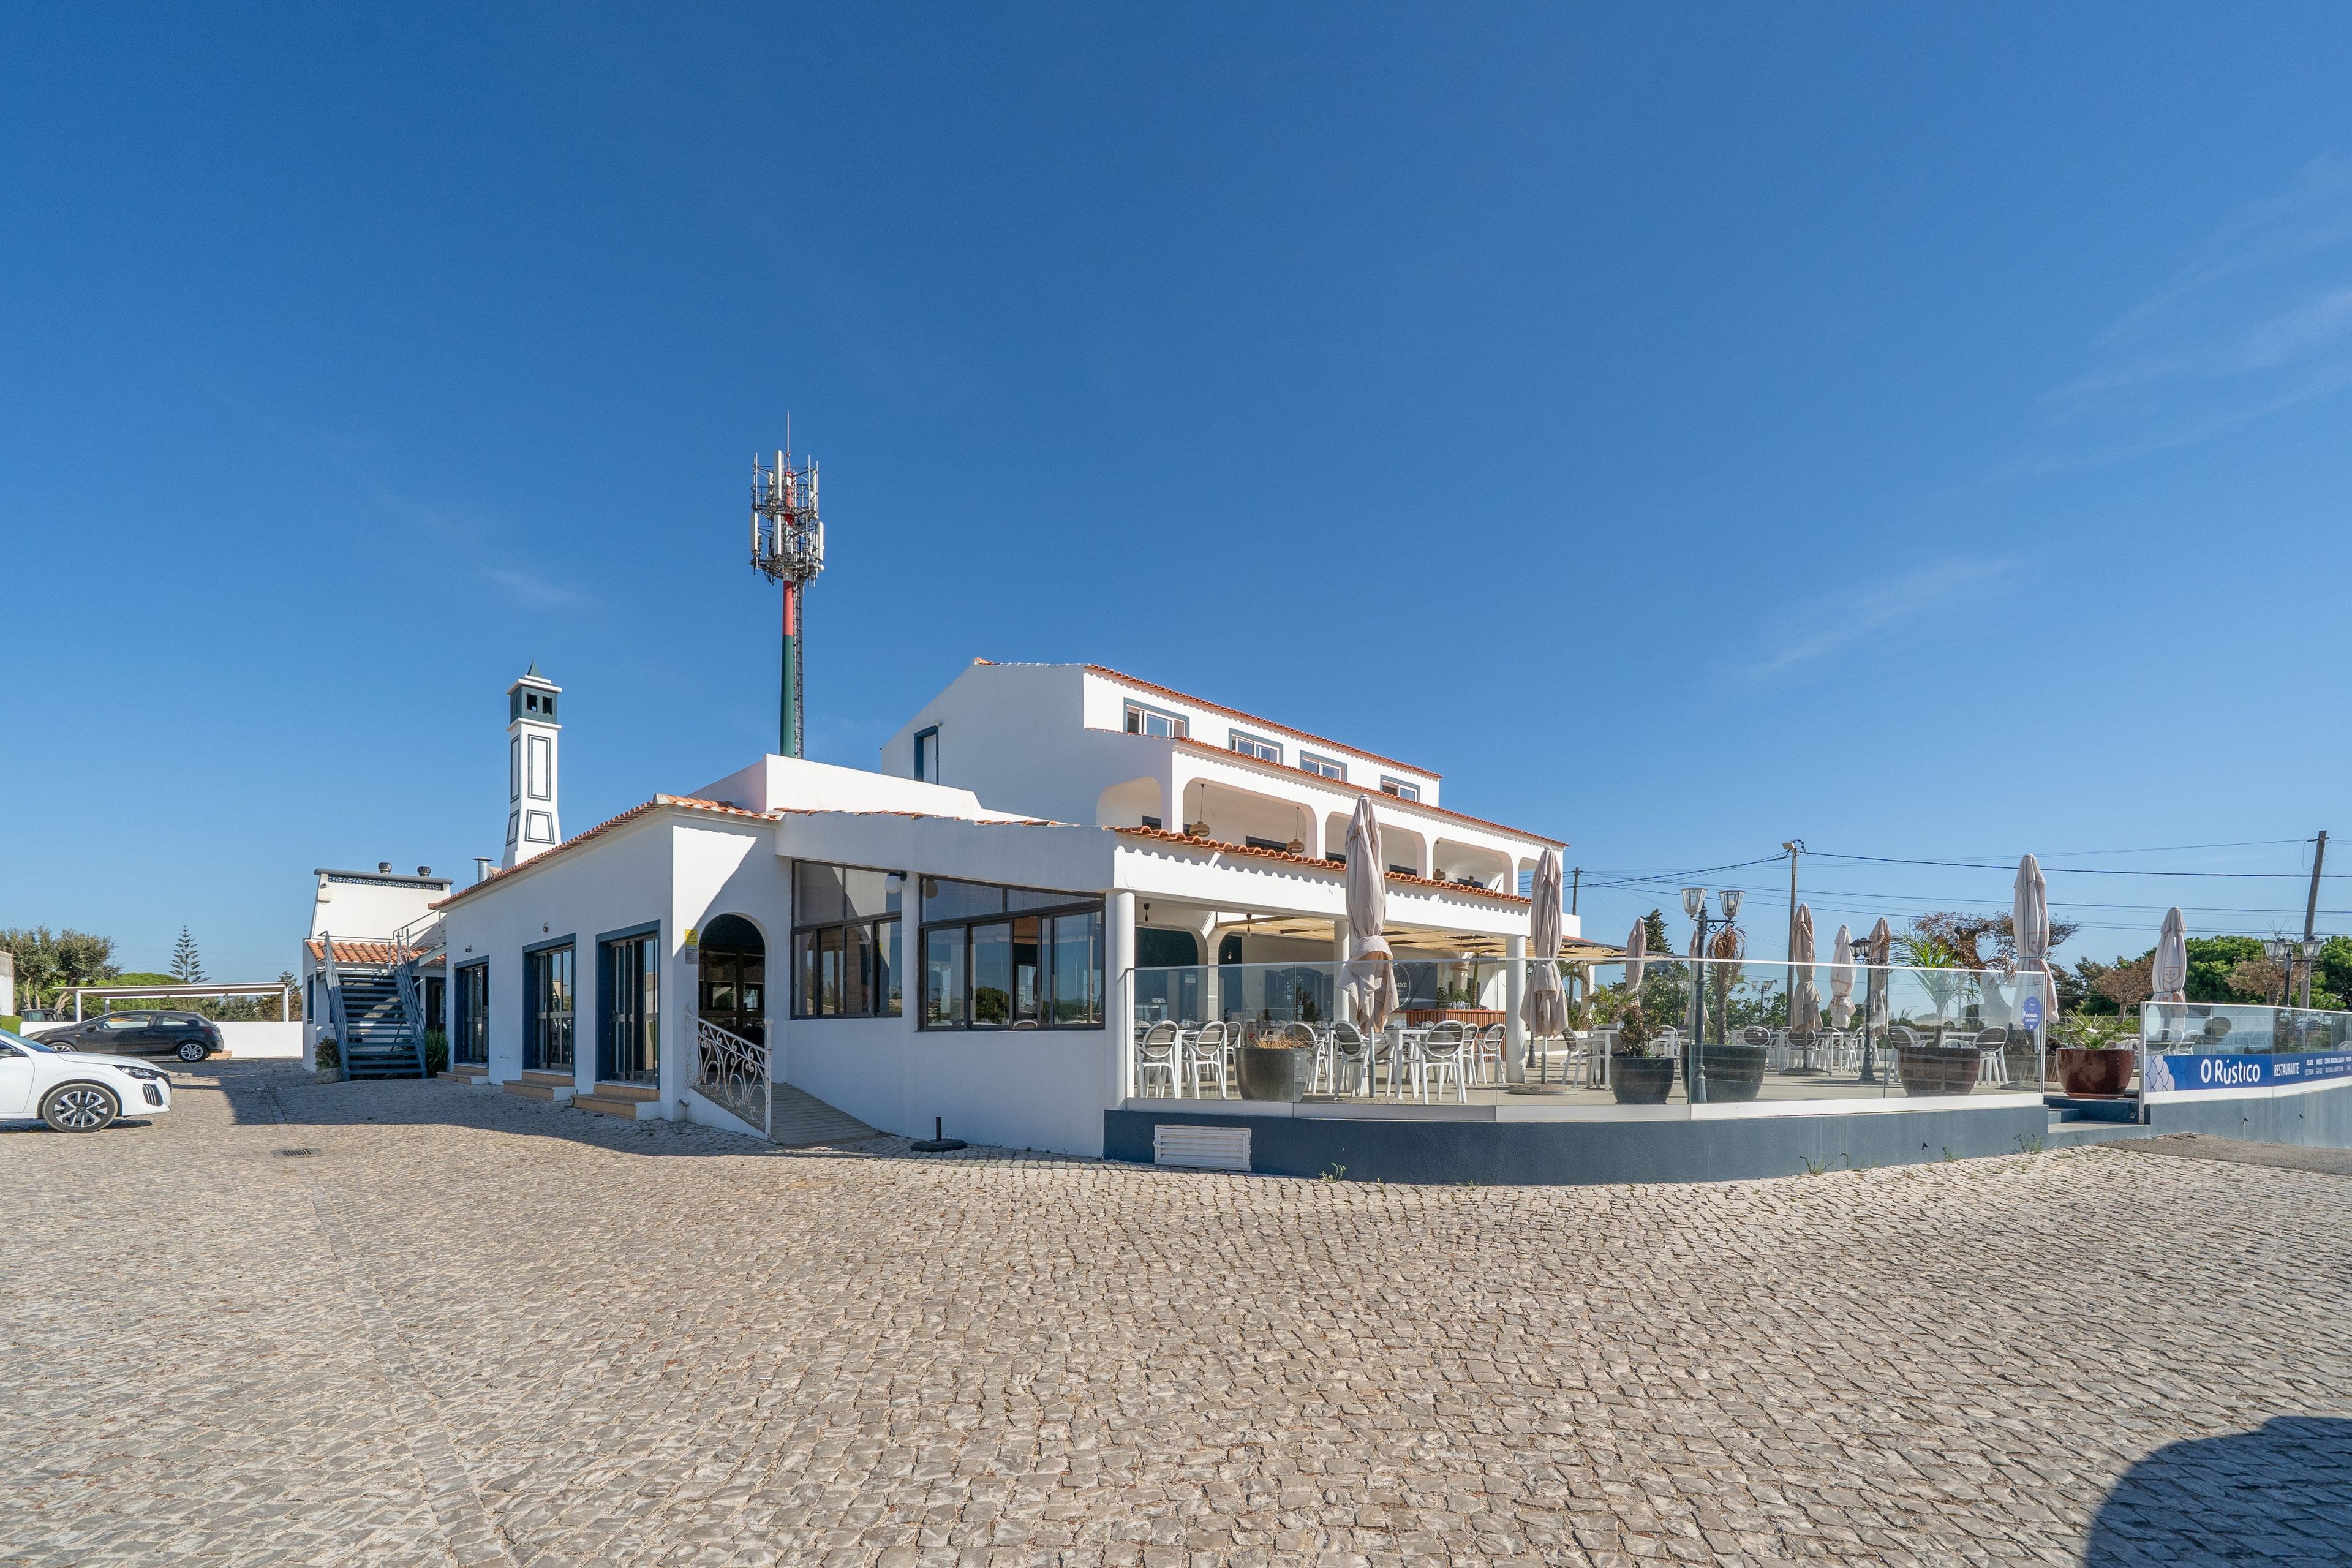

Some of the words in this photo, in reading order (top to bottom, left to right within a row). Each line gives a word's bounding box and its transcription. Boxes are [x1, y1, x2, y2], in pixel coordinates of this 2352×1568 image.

[2201, 1058, 2212, 1084] O
[2215, 1058, 2260, 1085] Rústico
[2274, 1062, 2299, 1077] RESTAURANTE
